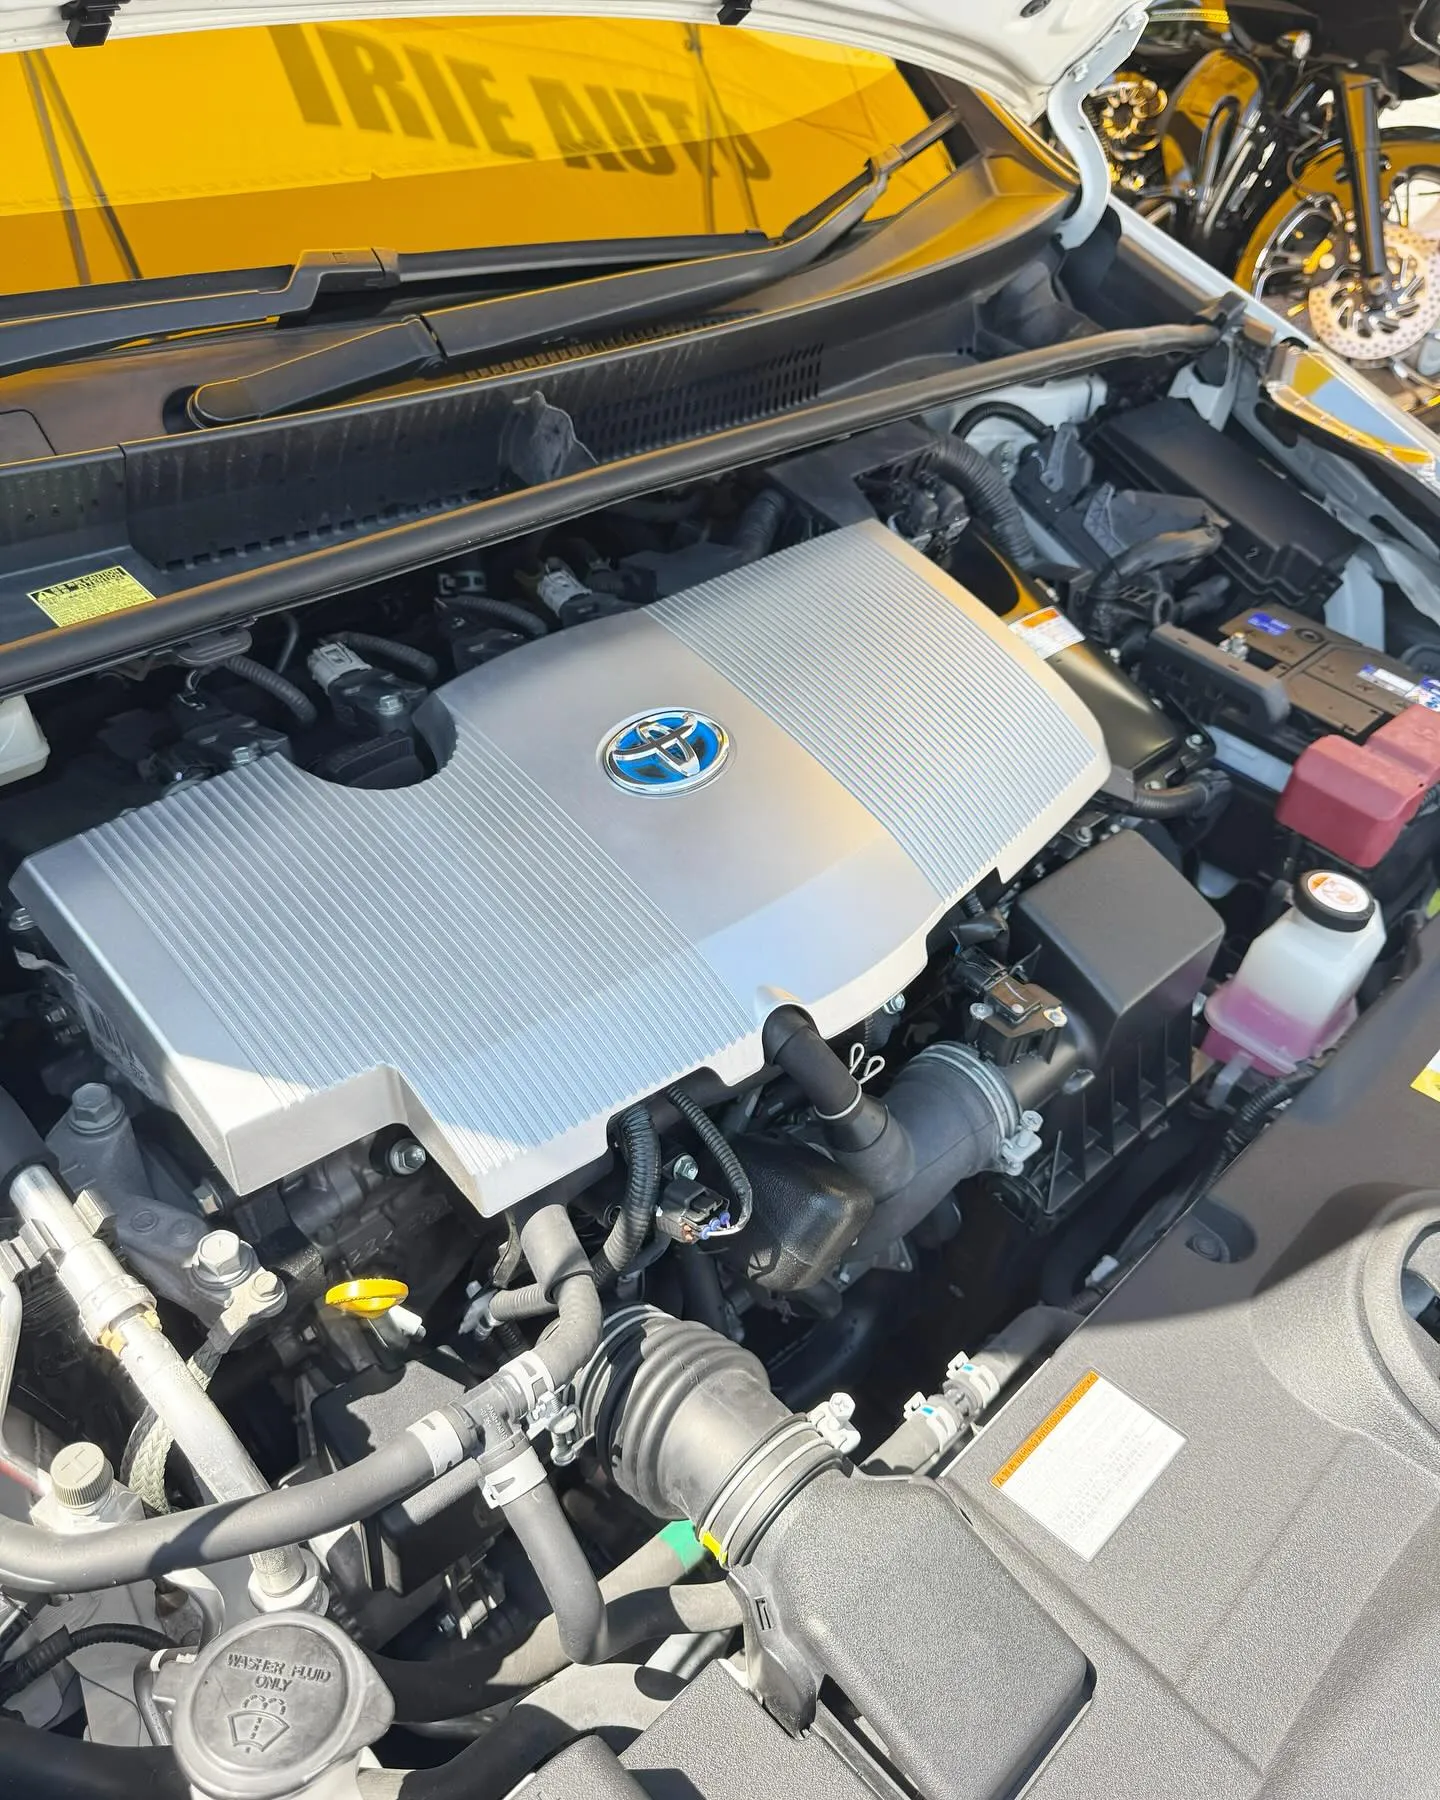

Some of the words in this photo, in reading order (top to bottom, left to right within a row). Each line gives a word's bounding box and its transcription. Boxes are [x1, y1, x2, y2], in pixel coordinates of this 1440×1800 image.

[267, 25, 536, 159] IRIE
[227, 1653, 286, 1675] WASHER
[291, 1665, 332, 1683] FLUID
[255, 1674, 292, 1692] ONLY
